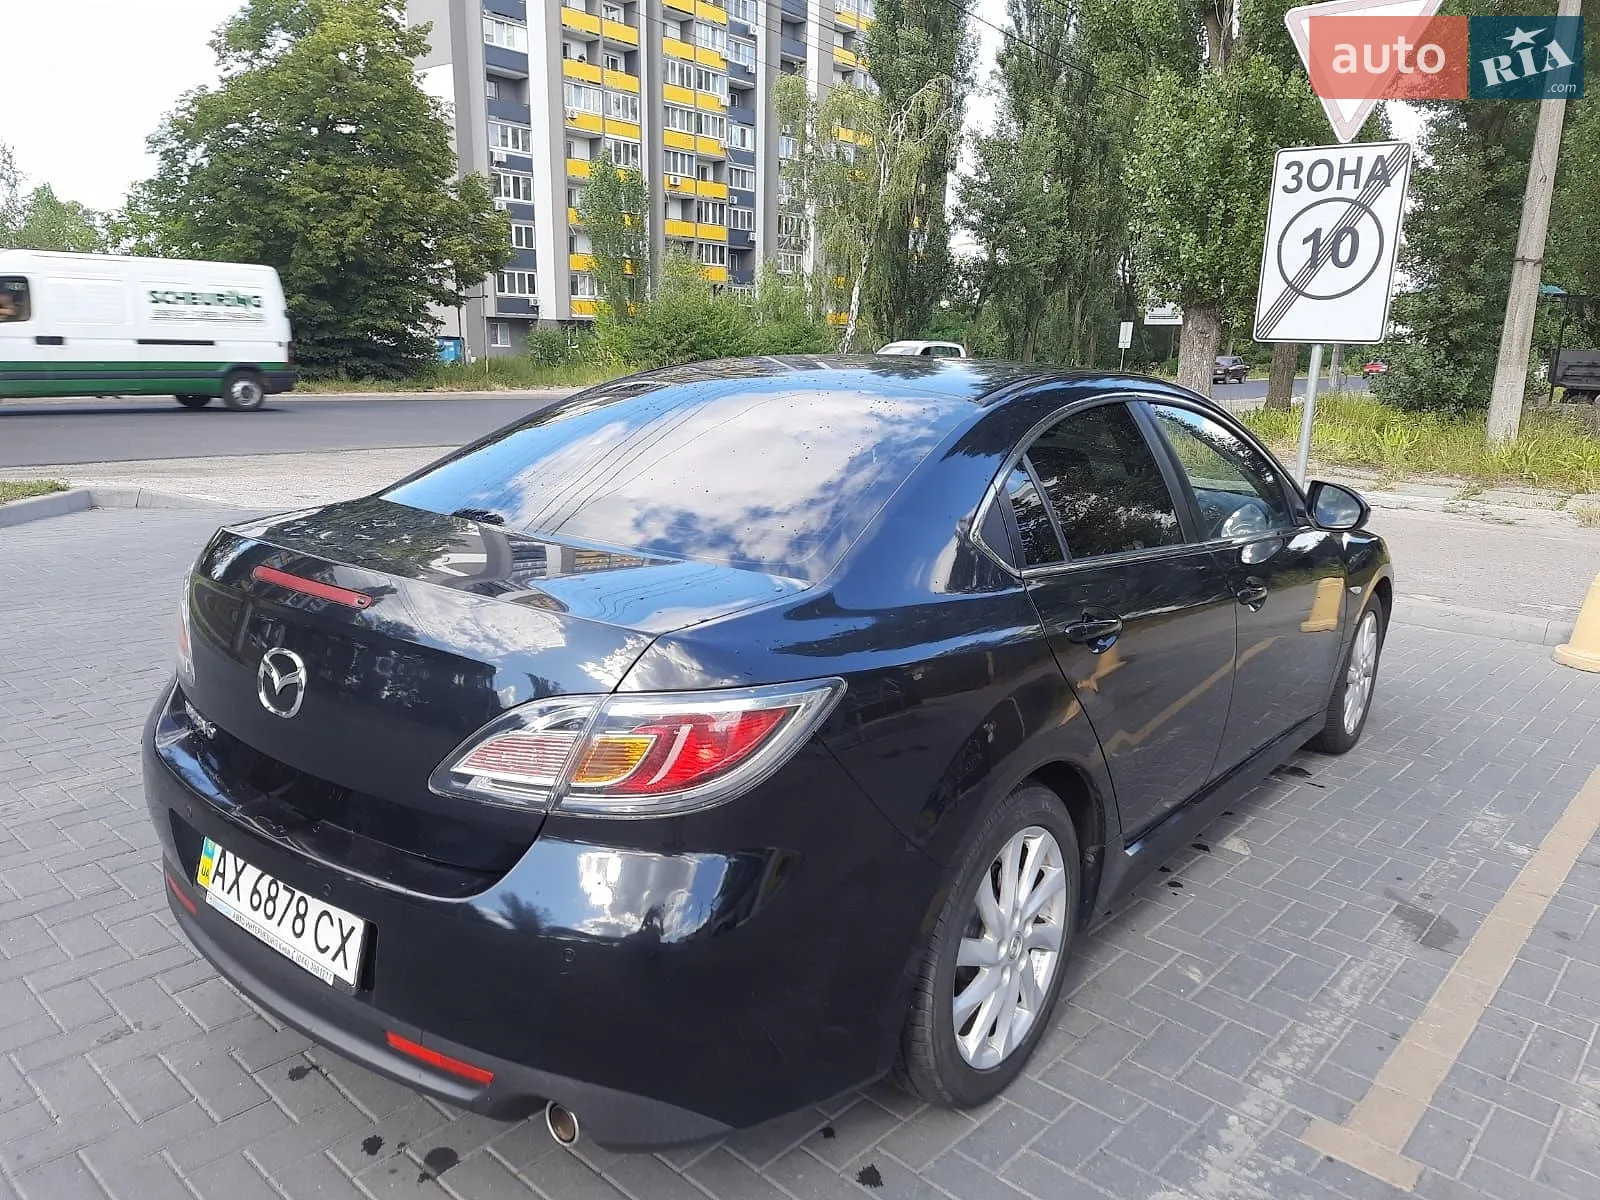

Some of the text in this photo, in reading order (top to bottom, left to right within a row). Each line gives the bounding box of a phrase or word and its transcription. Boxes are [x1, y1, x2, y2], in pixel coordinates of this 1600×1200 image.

[1282, 154, 1392, 194] ЗОНА
[1302, 226, 1360, 269] 10
[202, 866, 211, 878] UA
[212, 849, 247, 902] AX
[250, 872, 309, 939] 6878
[314, 910, 356, 971] CX
